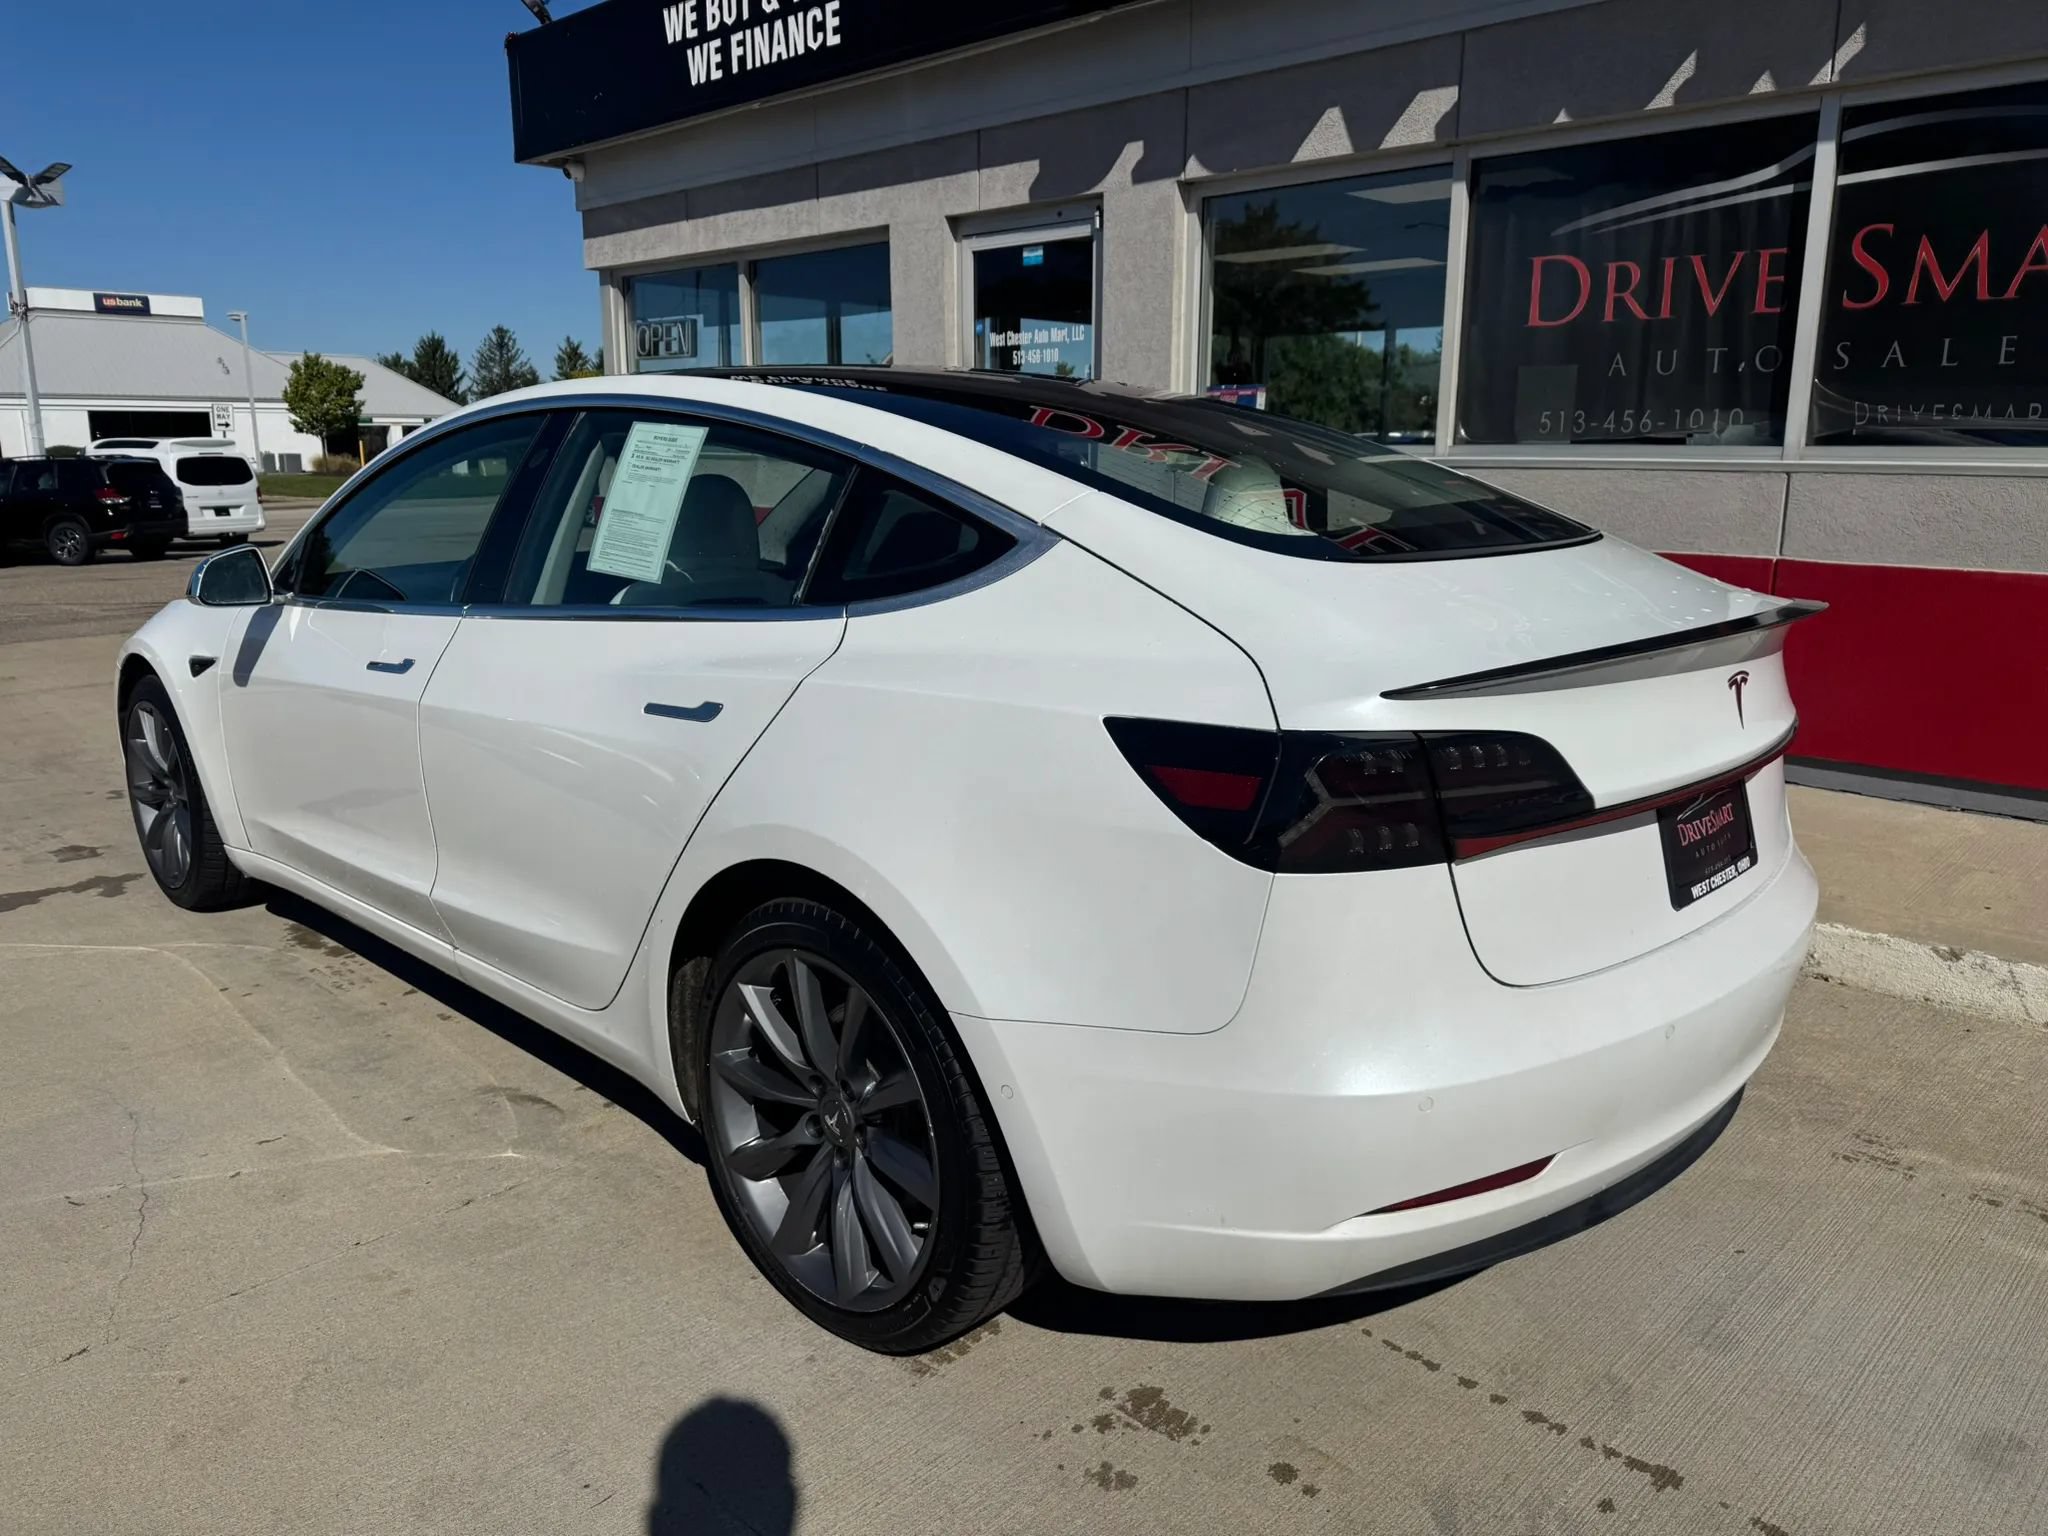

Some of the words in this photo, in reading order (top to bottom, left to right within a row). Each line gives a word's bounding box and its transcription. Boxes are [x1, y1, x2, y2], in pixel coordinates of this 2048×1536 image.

[663, 0, 698, 44] WE
[687, 38, 723, 86] WE
[730, 0, 841, 74] FINANCE
[1523, 246, 1791, 328] DRIVE
[636, 319, 692, 357] OPEN
[989, 330, 1006, 348] West
[1006, 328, 1033, 346] Chester
[1034, 328, 1049, 344] Auto
[1071, 324, 1085, 341] LLC
[1012, 348, 1059, 365] 513-456-1010
[1608, 344, 1783, 377] AUTO
[216, 406, 230, 414] ONE
[1538, 407, 1745, 434] 513-456-1010
[1690, 878, 1711, 899] WEST
